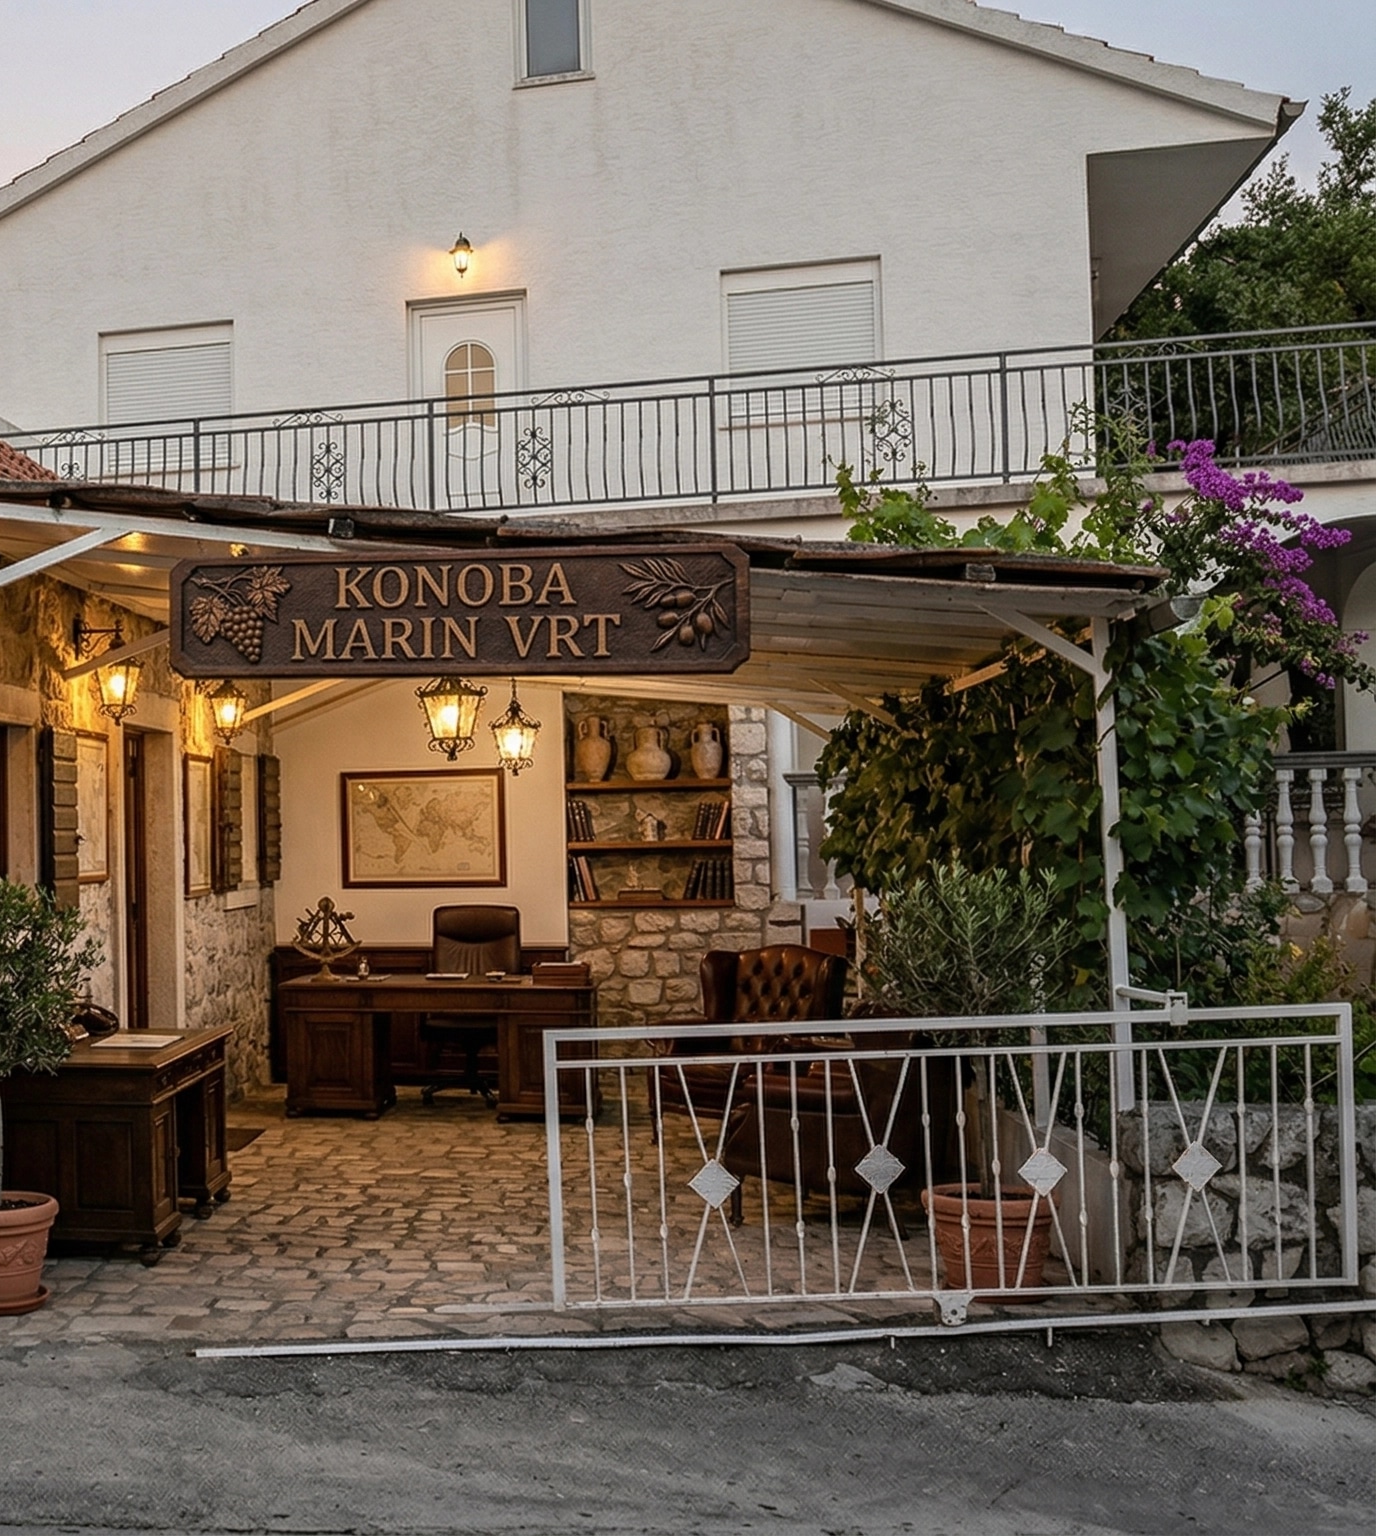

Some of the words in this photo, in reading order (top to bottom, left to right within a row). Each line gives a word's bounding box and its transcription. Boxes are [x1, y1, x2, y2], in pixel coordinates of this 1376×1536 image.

[335, 562, 577, 609] KONOBA
[291, 615, 478, 660] MARIN
[504, 613, 621, 659] VRT
